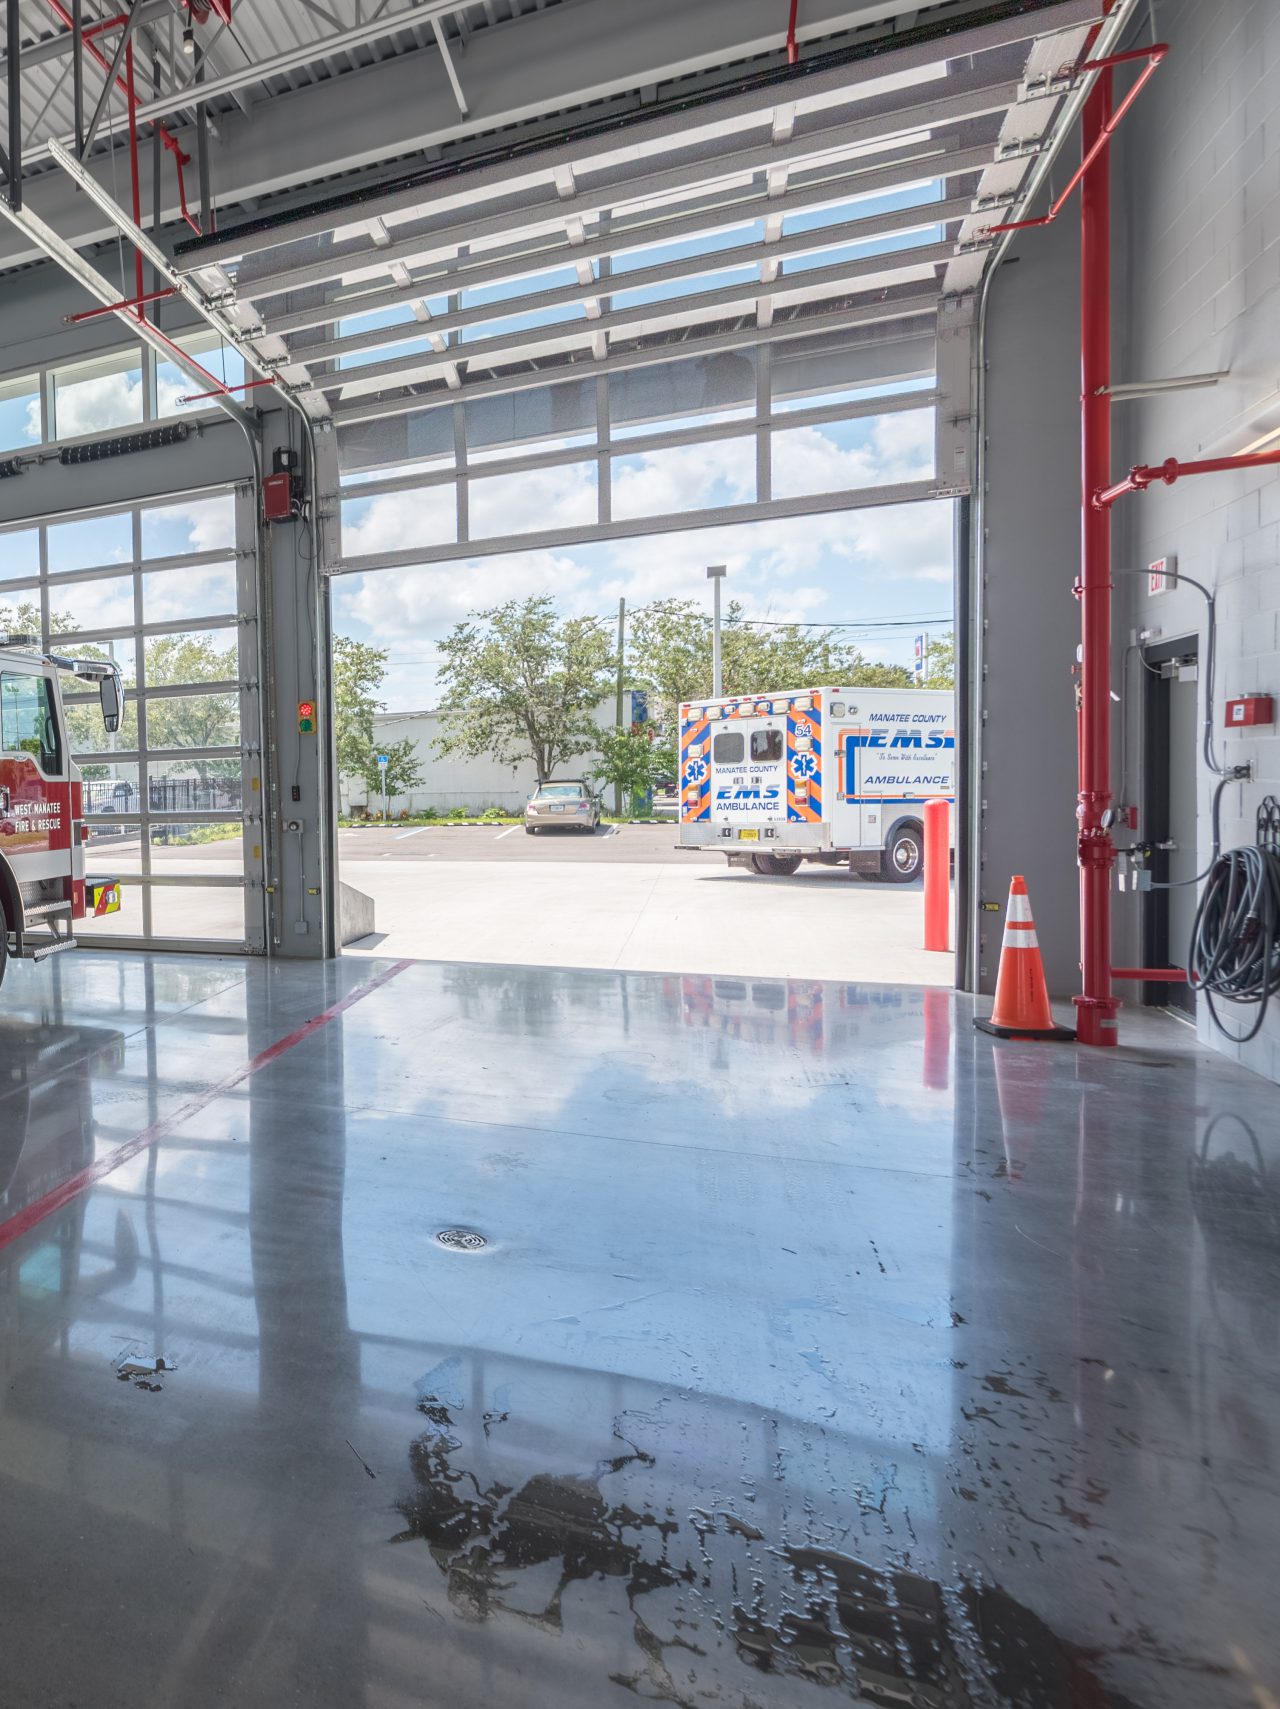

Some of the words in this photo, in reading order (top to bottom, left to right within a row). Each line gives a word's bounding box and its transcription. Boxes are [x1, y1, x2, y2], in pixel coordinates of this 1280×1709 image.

[1151, 561, 1164, 592] EXIT
[869, 713, 910, 722] MANATEE
[912, 714, 947, 723] COUNTY
[796, 724, 812, 736] 54
[868, 728, 945, 748] EMS
[715, 766, 747, 774] MANATEE
[749, 765, 778, 773] COUNTY
[864, 776, 949, 784] AMBULANCE
[716, 784, 781, 799] EMS
[14, 803, 32, 815] WEST
[34, 802, 61, 814] MANATEE
[716, 802, 780, 811] AMBULANCE
[15, 821, 30, 832] FIRE
[38, 818, 61, 830] RESCUE
